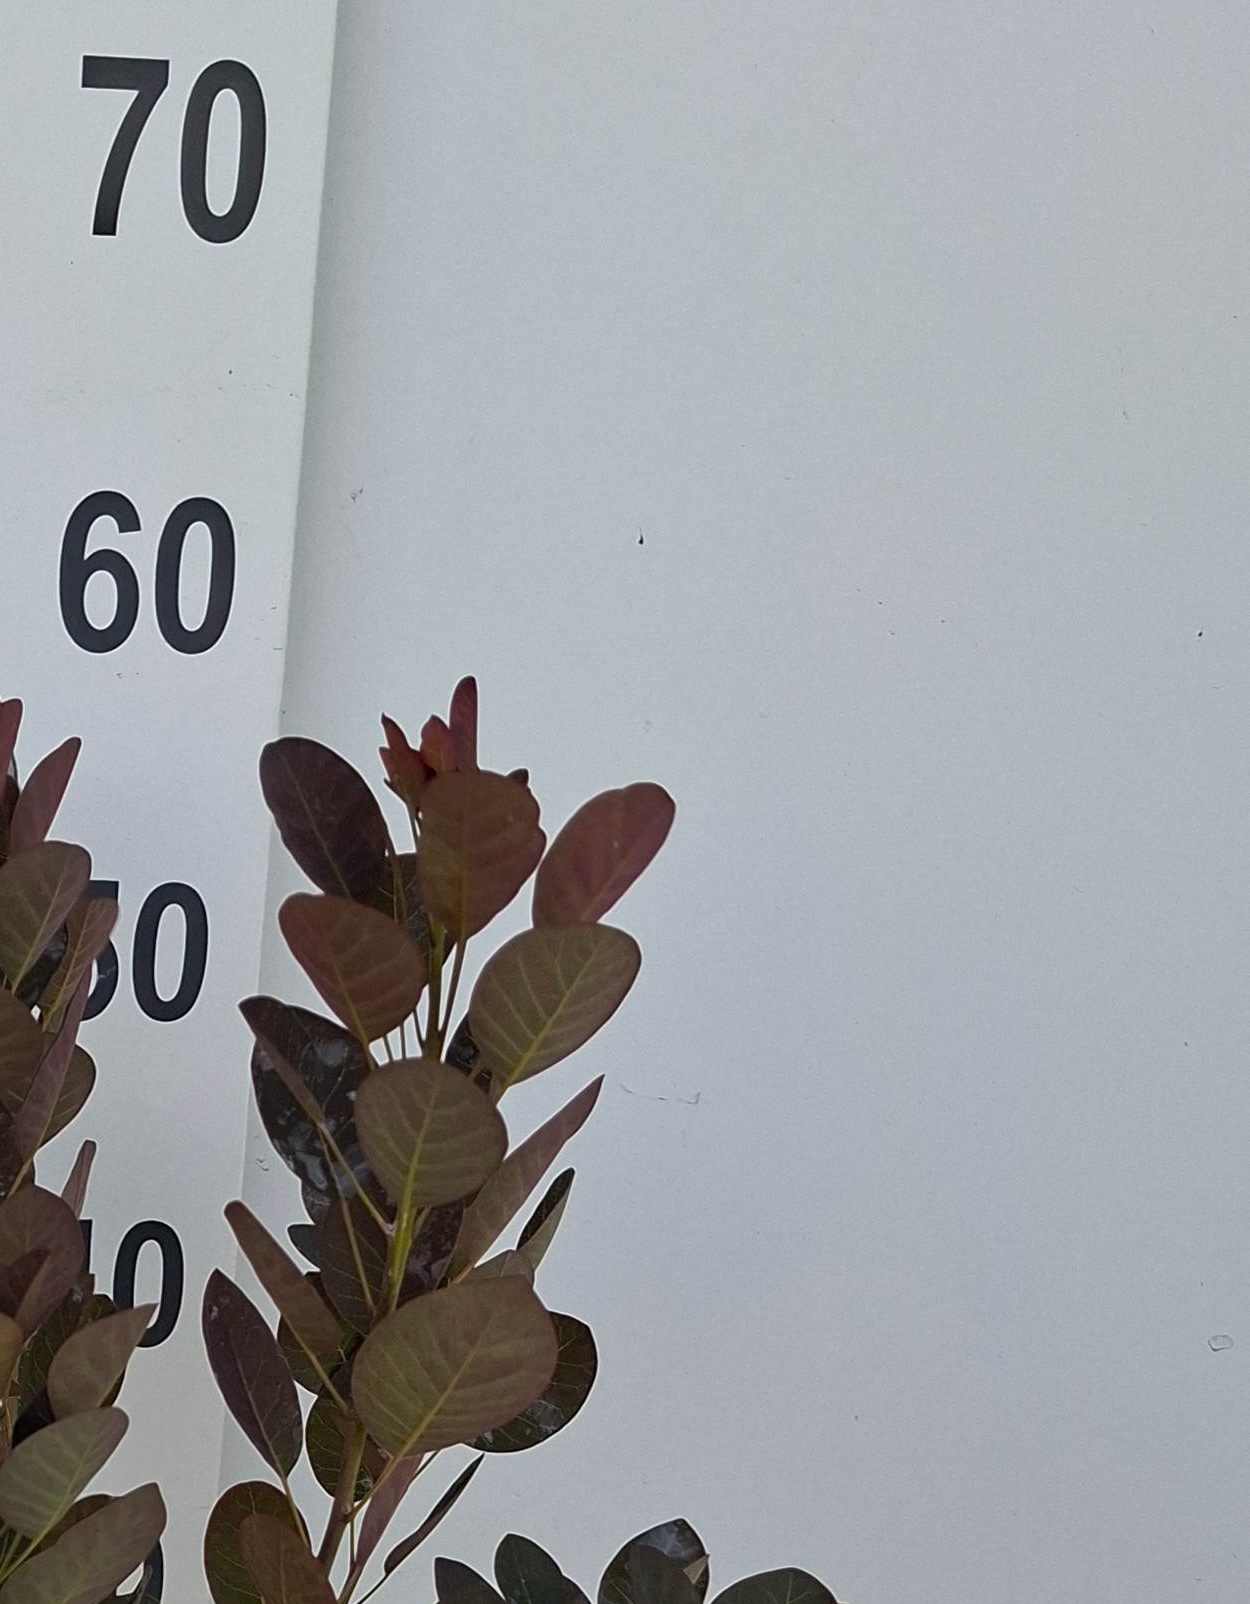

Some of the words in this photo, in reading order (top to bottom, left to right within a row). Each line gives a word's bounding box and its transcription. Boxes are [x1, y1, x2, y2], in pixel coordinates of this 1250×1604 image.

[81, 55, 266, 244] 70
[59, 490, 235, 654] 60
[80, 1219, 183, 1347] 0
